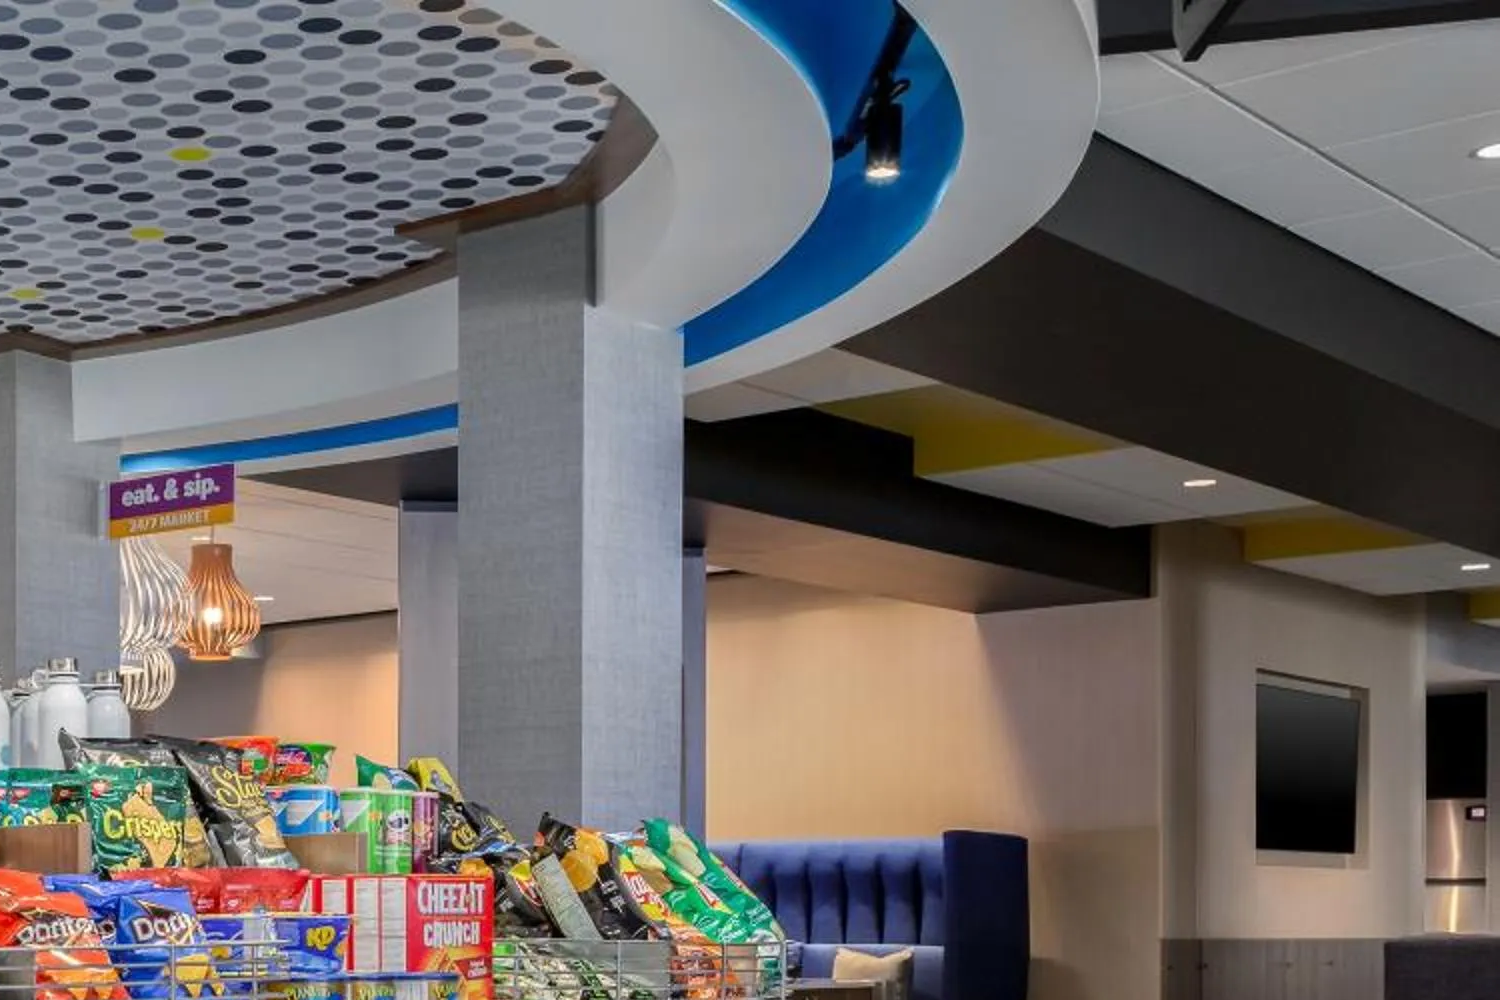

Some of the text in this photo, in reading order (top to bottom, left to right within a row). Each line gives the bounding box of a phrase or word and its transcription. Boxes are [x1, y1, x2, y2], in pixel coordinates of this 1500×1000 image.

[122, 472, 220, 507] eat. & sip.
[163, 510, 212, 528] MARKET
[417, 881, 486, 914] CHEEZ-IT
[423, 921, 481, 947] CRUNCH
